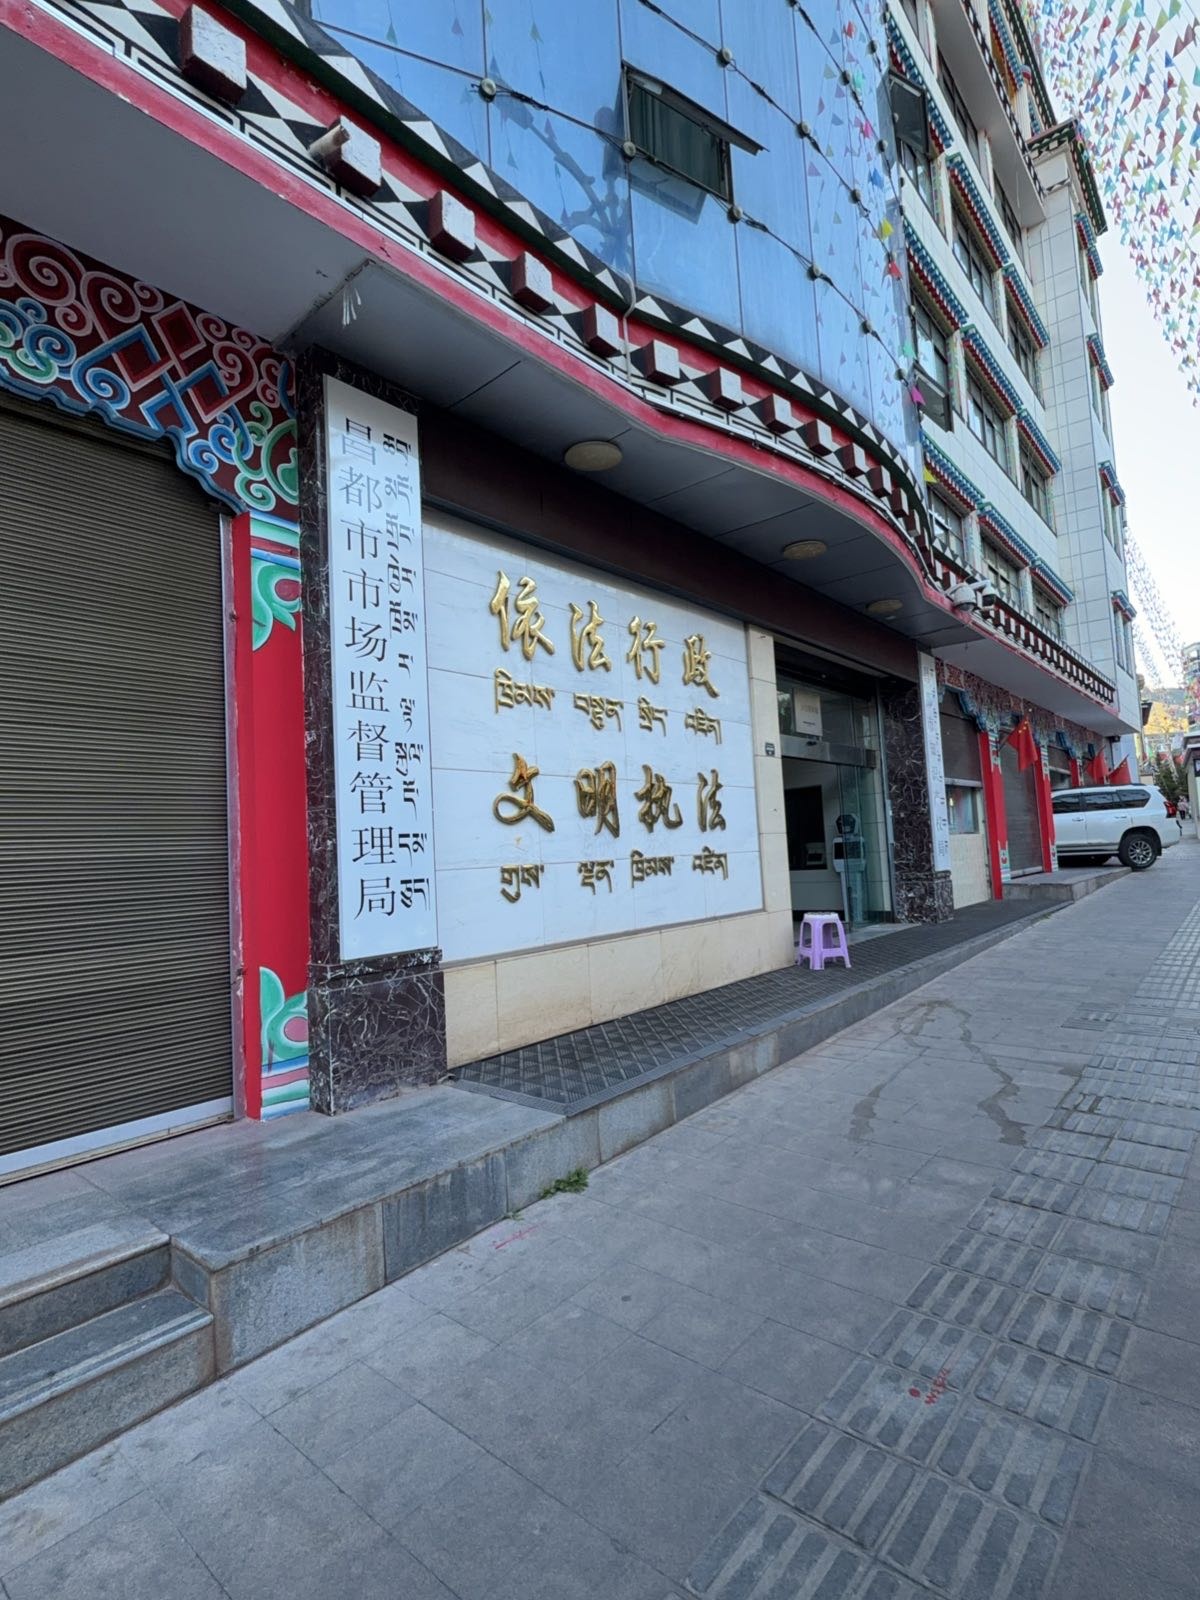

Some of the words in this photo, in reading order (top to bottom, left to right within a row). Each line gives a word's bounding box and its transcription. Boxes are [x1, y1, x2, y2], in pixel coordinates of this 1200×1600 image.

[339, 417, 397, 920] 昌都市市场监督管理局
[490, 570, 720, 699] 依法行政
[493, 752, 727, 838] 文明执法
